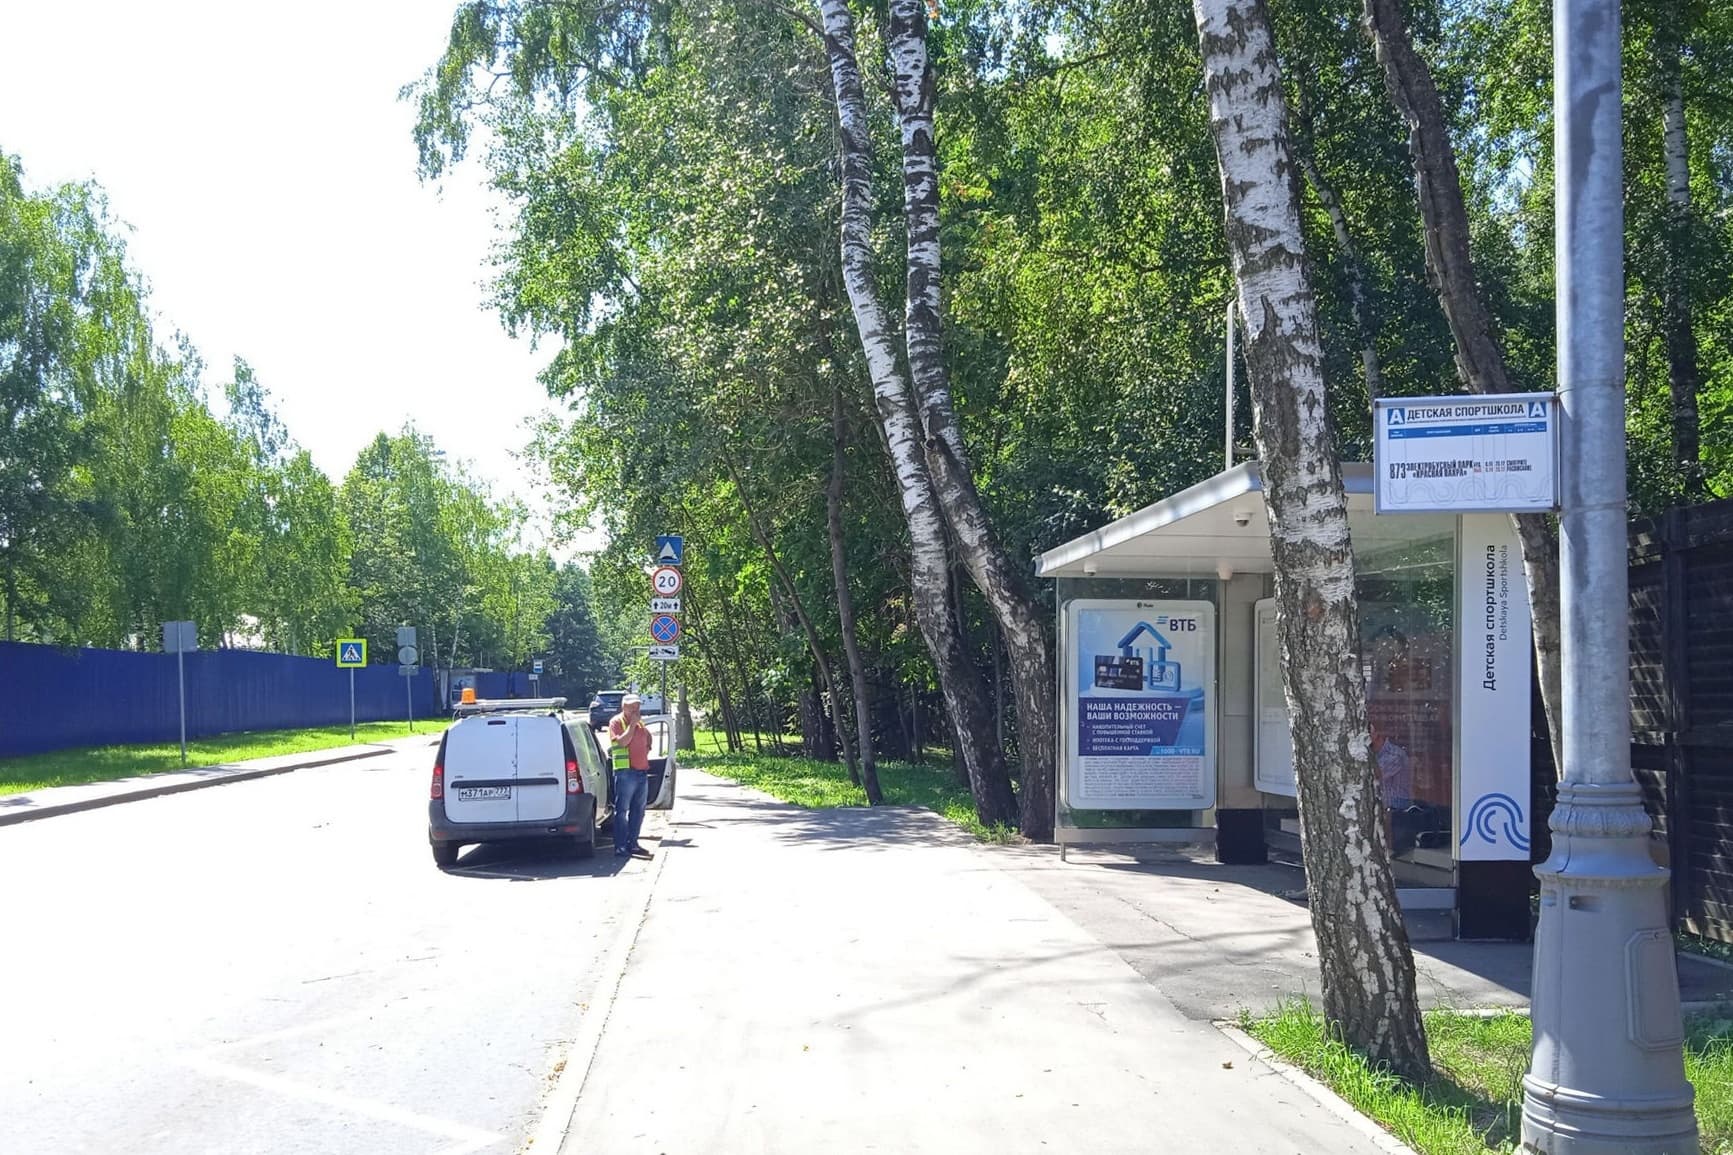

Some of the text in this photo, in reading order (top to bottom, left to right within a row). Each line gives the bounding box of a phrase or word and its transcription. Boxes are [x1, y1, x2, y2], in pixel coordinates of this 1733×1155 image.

[1407, 404, 1524, 420] ДЕТСКАЯ СПОРТШКОЛА
[1390, 462, 1406, 479] 873
[658, 576, 676, 587] 20
[1499, 545, 1508, 641] Detskaya Sportshkola
[1169, 619, 1196, 631] ВТБ
[1483, 545, 1497, 691] Детская спортшкола
[1086, 703, 1111, 711] НАША
[1114, 703, 1173, 712] НАДЕЖНОСТЬ
[1086, 712, 1179, 720] ВАШИ ВОЗМОЖНОСТИ
